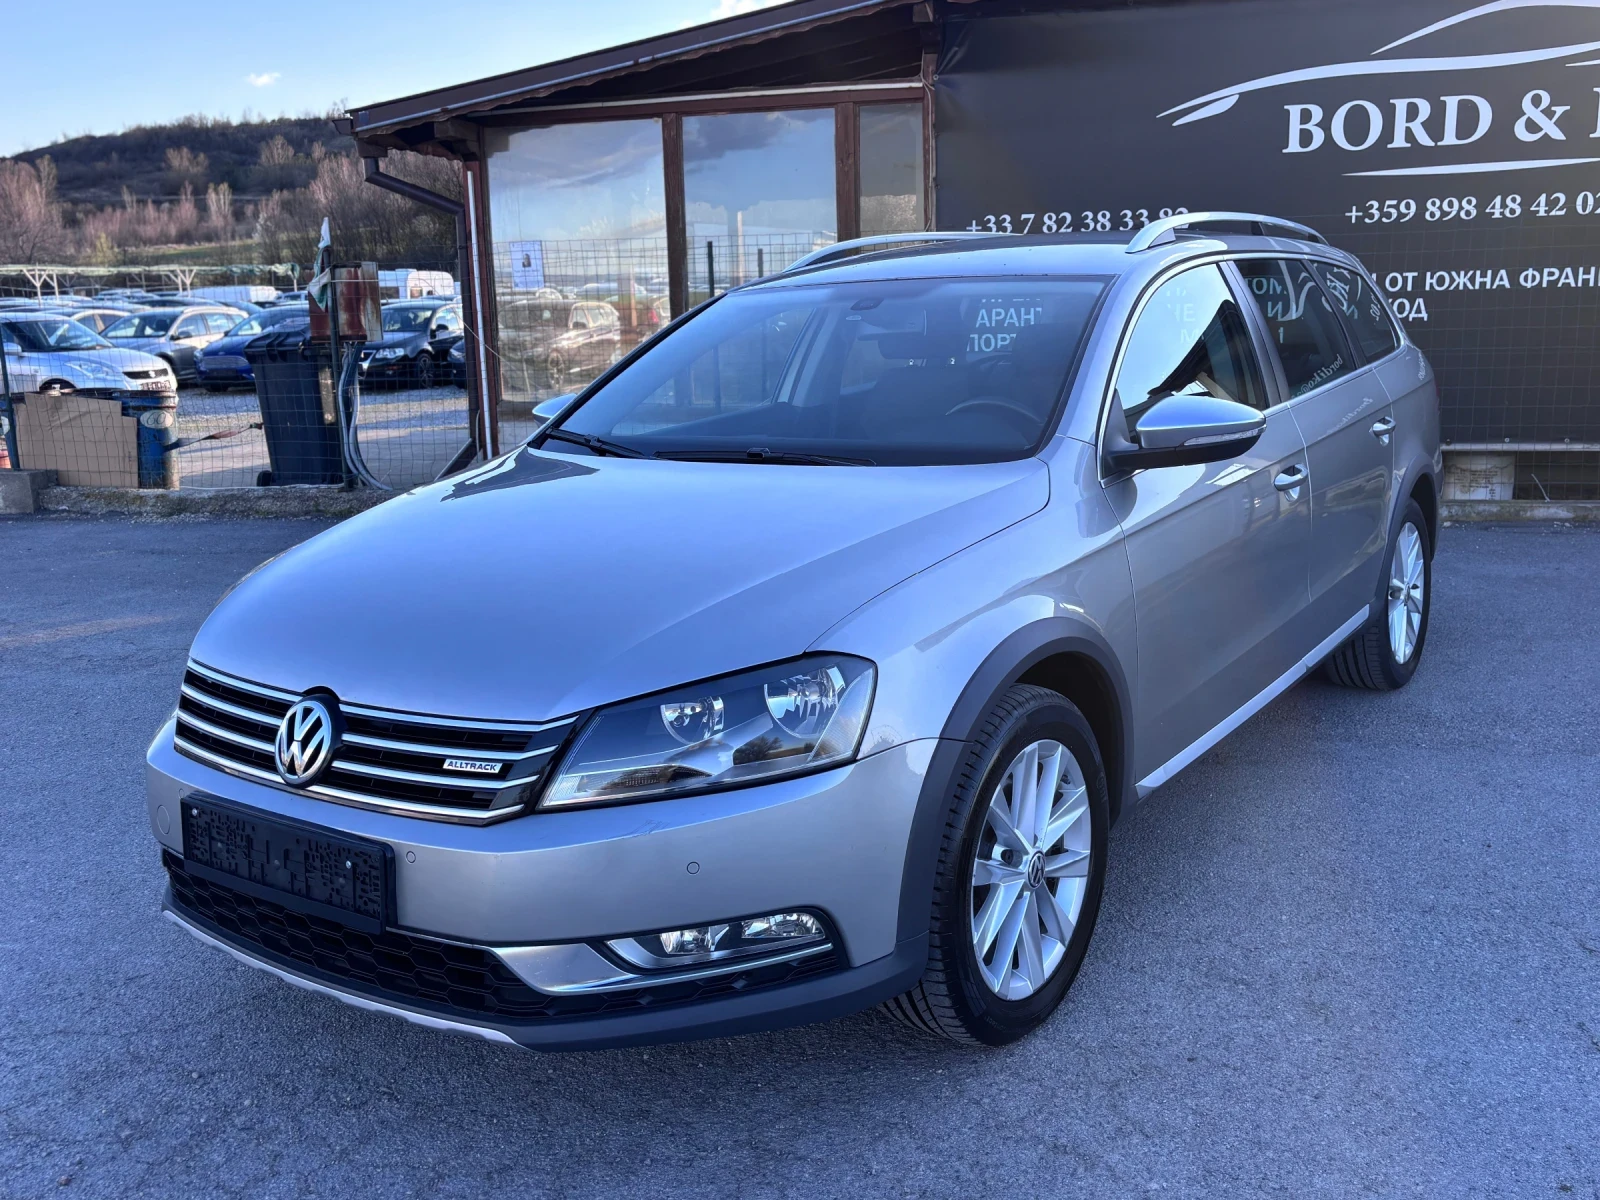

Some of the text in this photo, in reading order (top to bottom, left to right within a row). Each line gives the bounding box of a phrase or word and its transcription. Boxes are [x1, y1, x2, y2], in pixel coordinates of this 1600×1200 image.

[1282, 94, 1493, 153] BORD
[1513, 89, 1571, 142] &
[1344, 199, 1417, 225] +359
[1424, 196, 1478, 221] 898
[1485, 194, 1522, 219] 48
[1529, 191, 1567, 217] 42
[966, 214, 1013, 235] +33
[1020, 213, 1036, 235] 7
[1042, 212, 1074, 234] 82
[1080, 210, 1112, 232] 38
[1119, 209, 1150, 231] 33
[1385, 271, 1418, 293] ОТ
[1424, 268, 1511, 292] ЮЖНА
[1518, 265, 1600, 289] ФРАН
[1388, 297, 1428, 322] ОД
[446, 759, 498, 772] ALLTRACK
